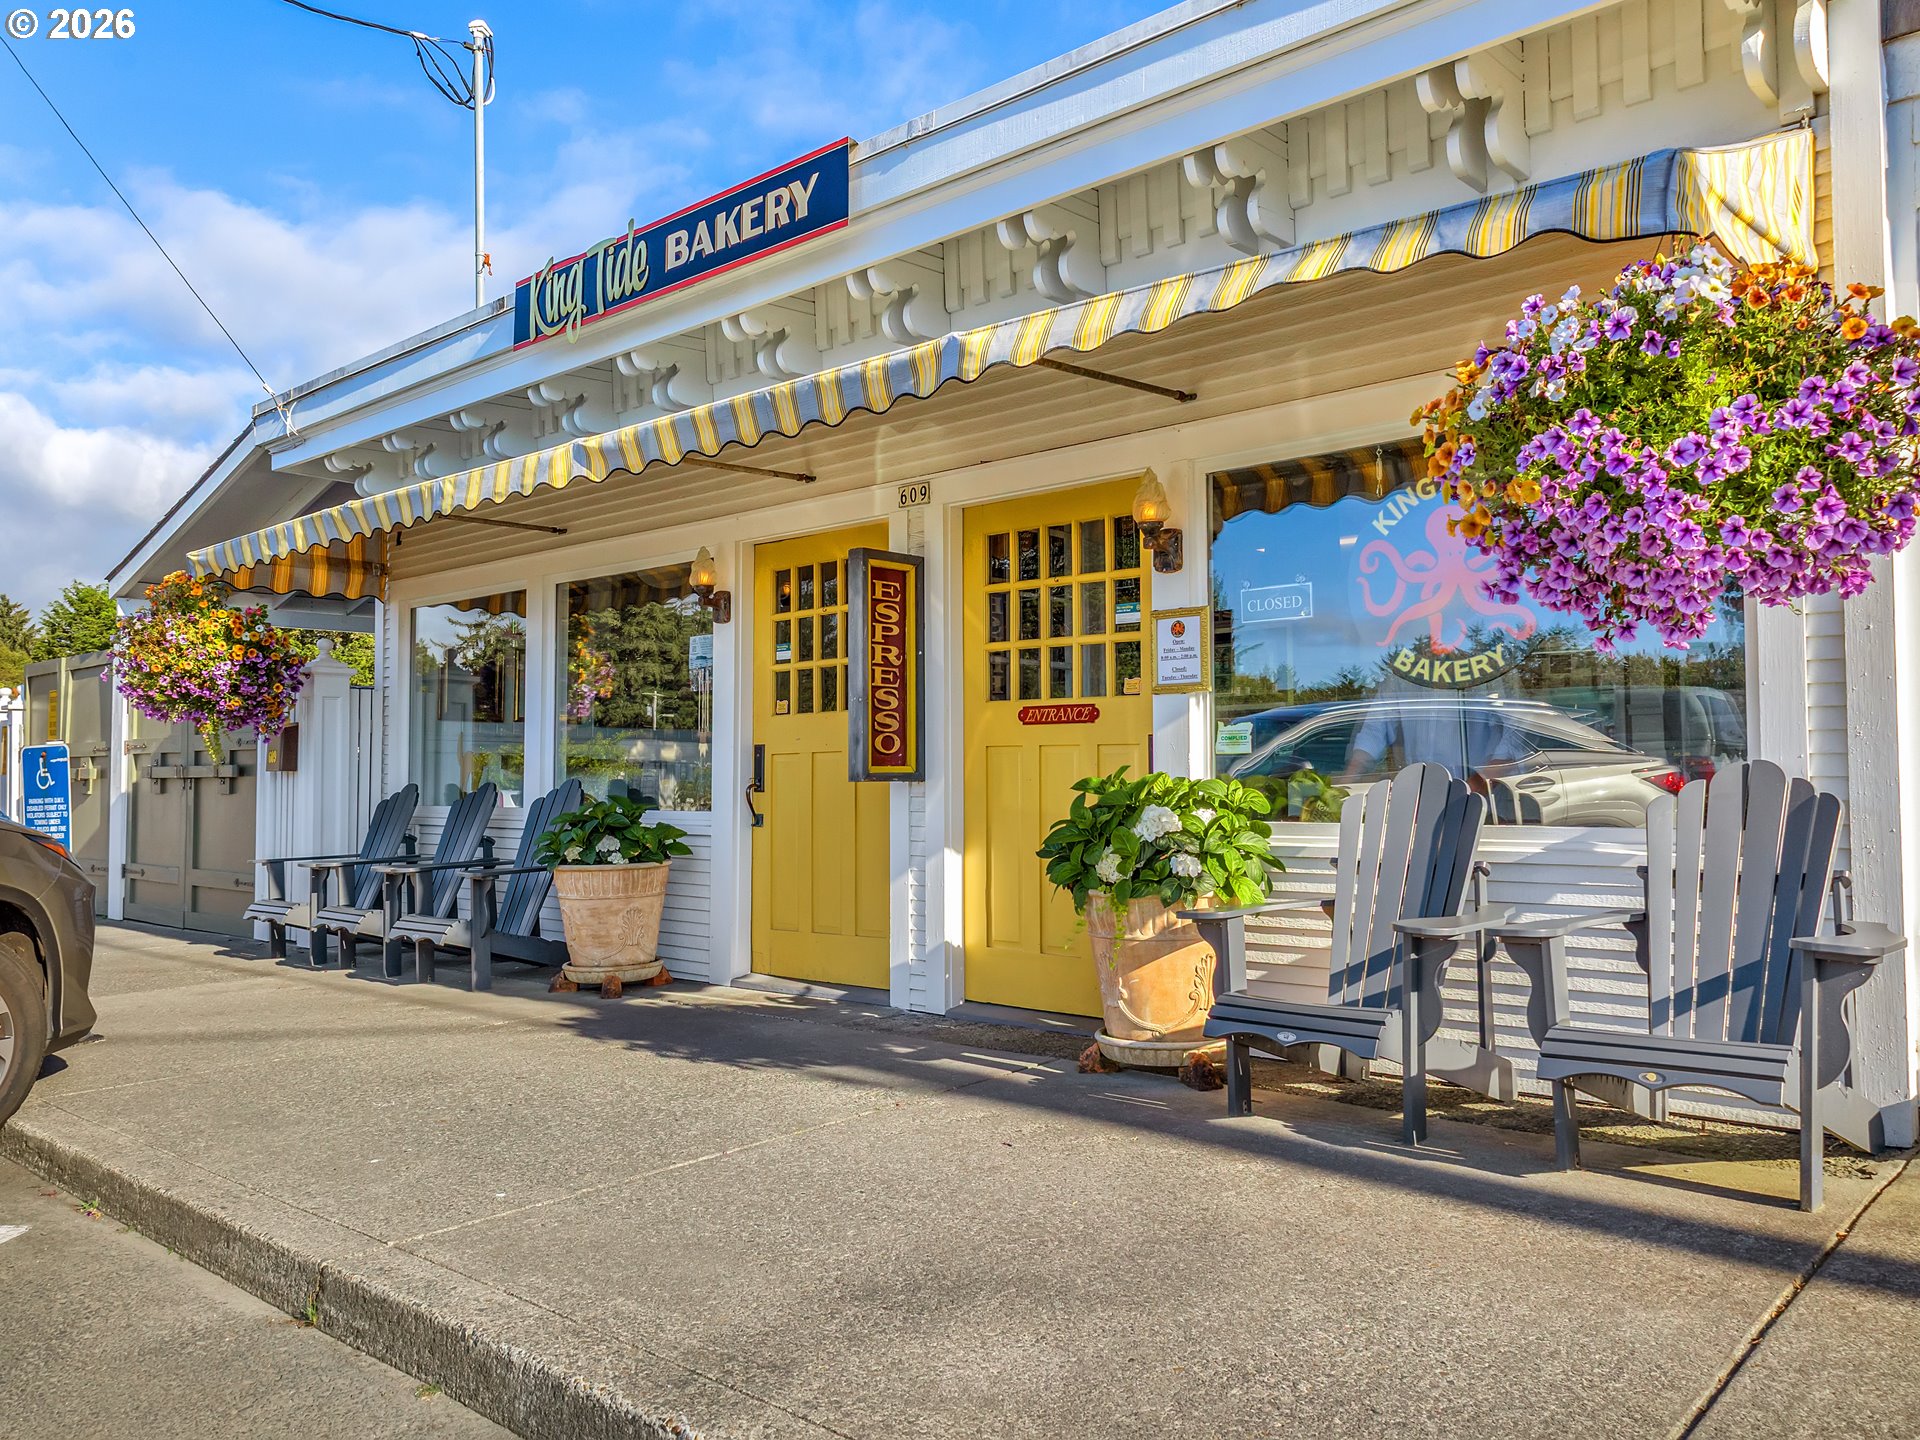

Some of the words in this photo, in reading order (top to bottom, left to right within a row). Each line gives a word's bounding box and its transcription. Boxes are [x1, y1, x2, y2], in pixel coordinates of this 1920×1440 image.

[528, 256, 587, 344] King
[586, 218, 649, 315] Tide
[664, 172, 820, 273] BAKERY
[900, 485, 927, 505] 609
[1372, 478, 1438, 537] KING
[1247, 595, 1303, 613] CLOSED
[871, 579, 903, 755] ESPRESSO
[1393, 644, 1506, 684] BAKERY
[1024, 707, 1092, 722] ENTRANCE
